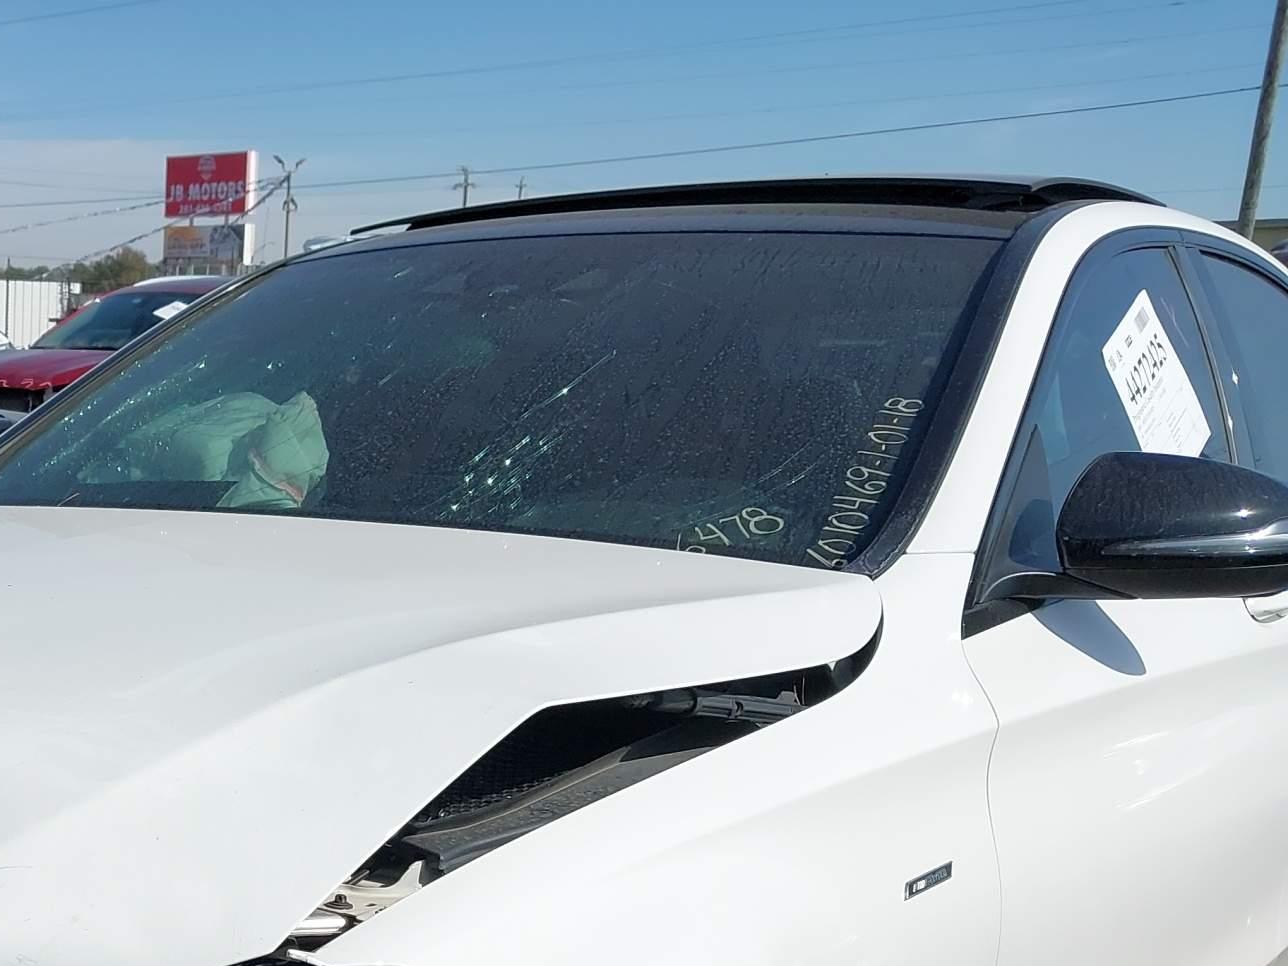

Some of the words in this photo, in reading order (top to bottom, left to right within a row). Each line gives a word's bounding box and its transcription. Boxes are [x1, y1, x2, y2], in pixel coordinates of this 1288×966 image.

[168, 183, 184, 202] JB
[188, 180, 245, 201] MOTORS
[1125, 333, 1168, 405] 44272425
